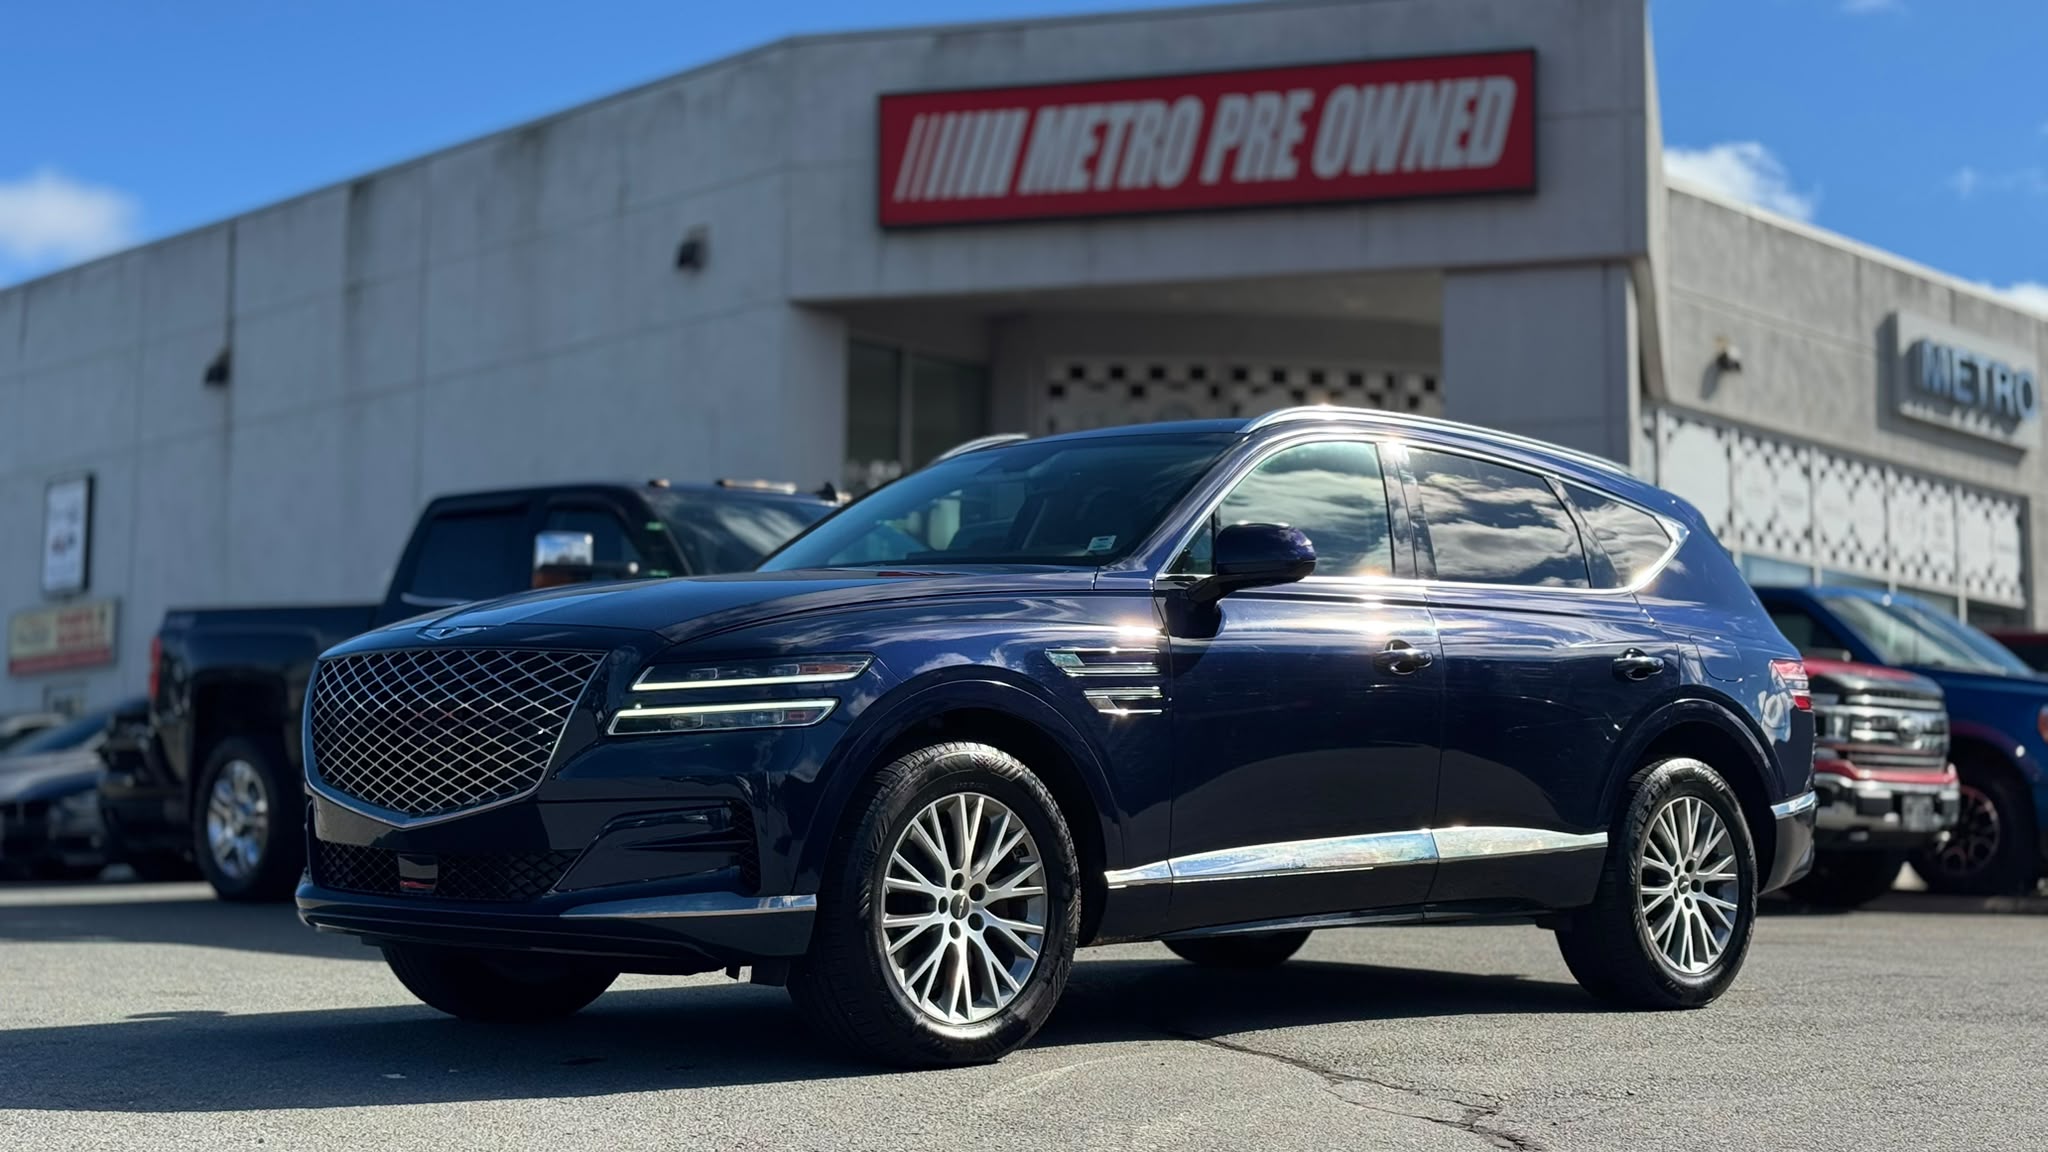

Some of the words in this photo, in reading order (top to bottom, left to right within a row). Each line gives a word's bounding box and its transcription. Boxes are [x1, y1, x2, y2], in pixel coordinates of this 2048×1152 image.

[1019, 97, 1202, 193] METRO
[1203, 90, 1313, 183] PRE
[1313, 76, 1515, 179] OWNED
[1921, 339, 2038, 421] METRO
